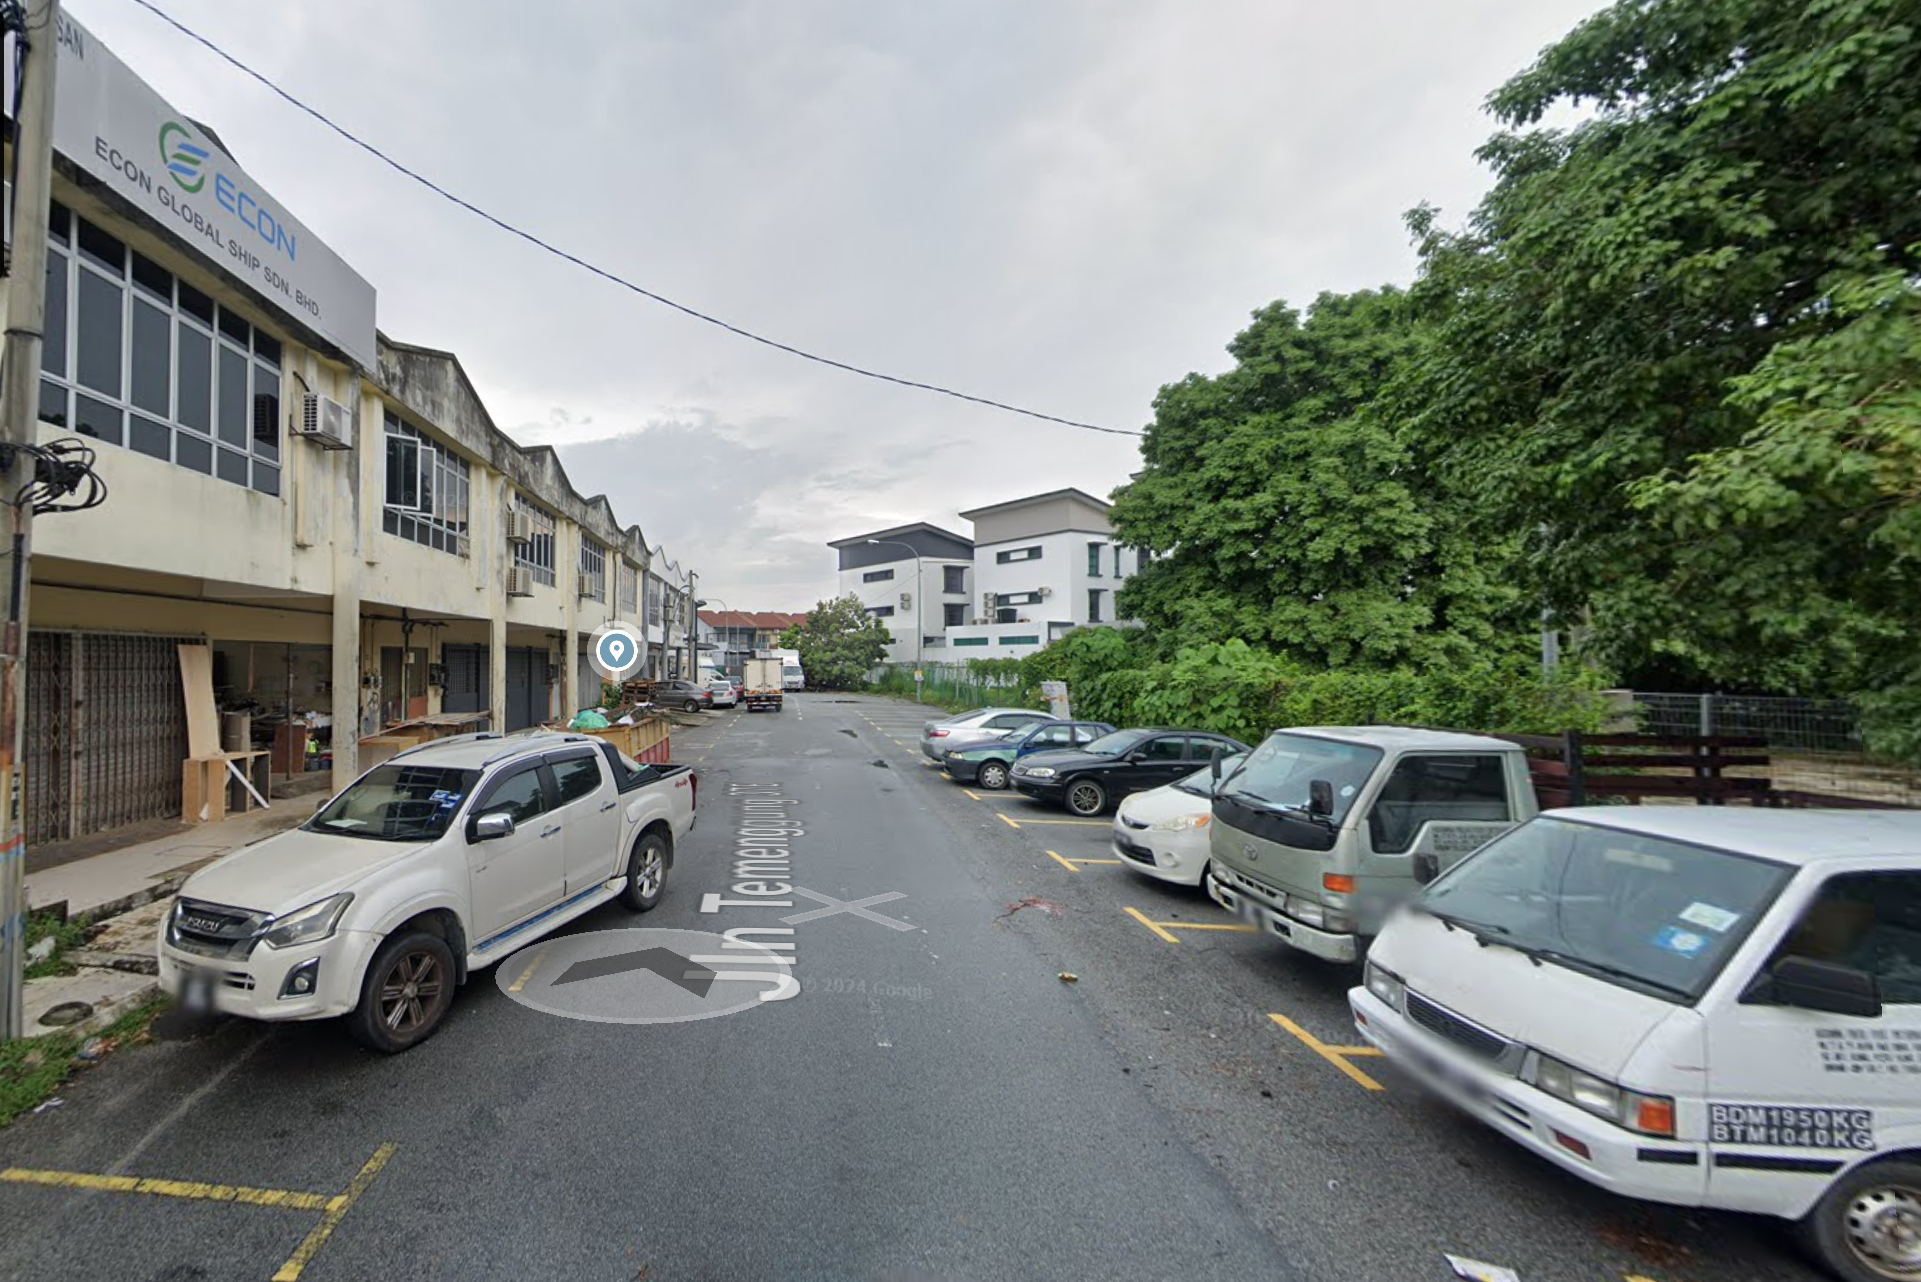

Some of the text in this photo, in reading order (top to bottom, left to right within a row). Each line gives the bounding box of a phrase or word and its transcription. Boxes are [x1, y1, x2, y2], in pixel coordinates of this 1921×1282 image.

[95, 136, 322, 320] ECON GLOBAL SHIP SDN. BHD.
[214, 173, 296, 261] ECON
